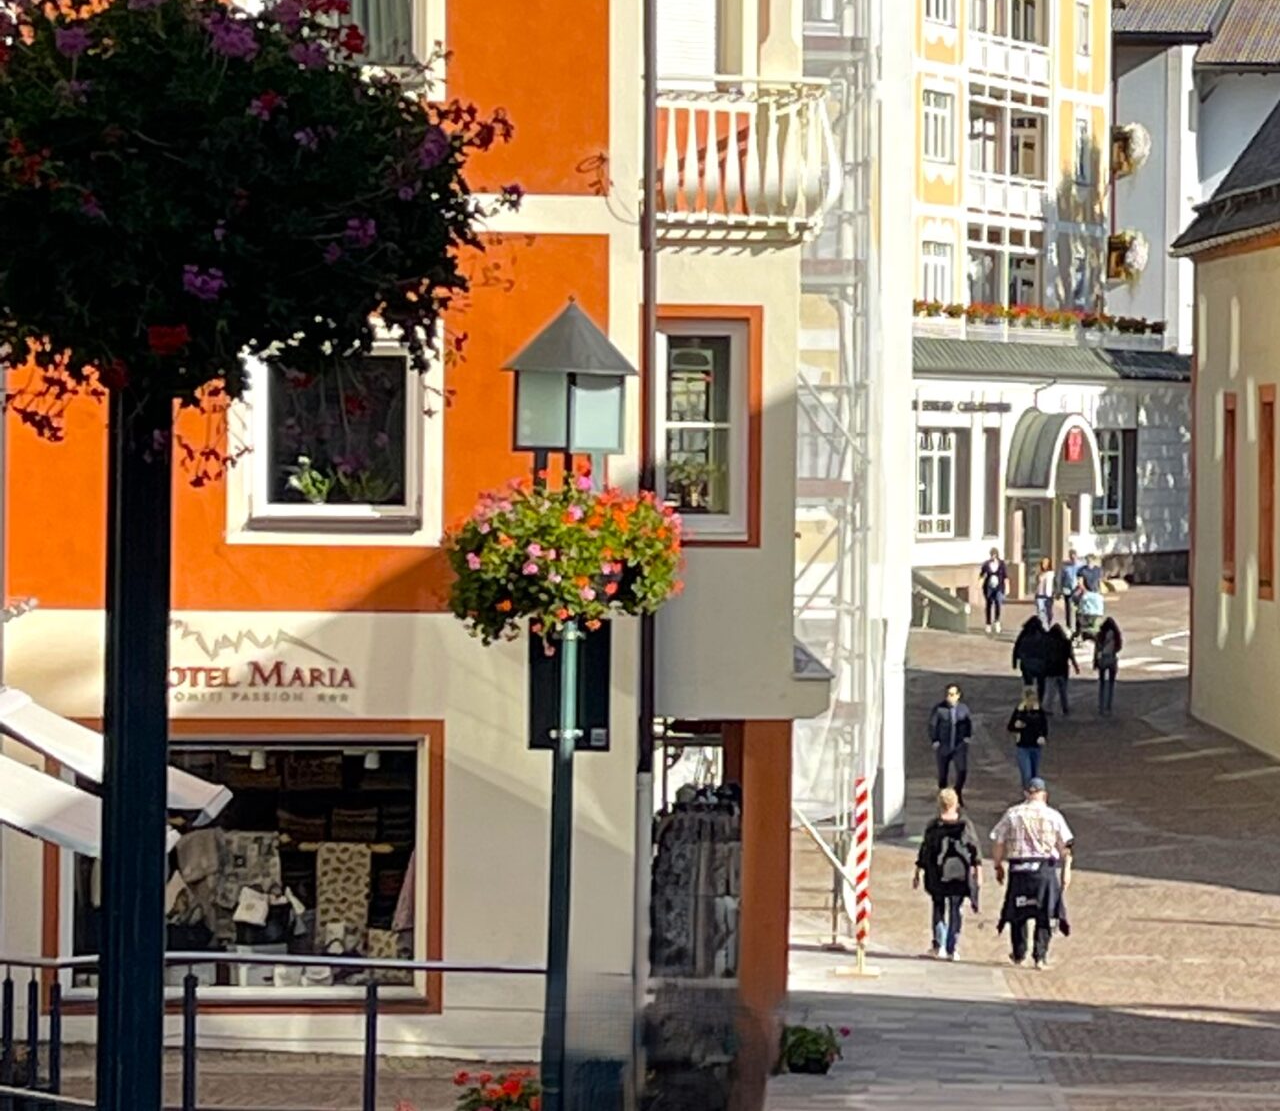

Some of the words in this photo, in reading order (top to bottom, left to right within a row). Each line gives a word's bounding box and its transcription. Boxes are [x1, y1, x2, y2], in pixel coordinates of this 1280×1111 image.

[168, 666, 240, 688] OTEL
[248, 660, 356, 688] MARIA
[174, 691, 223, 703] OMITI
[231, 691, 304, 703] PASSION
